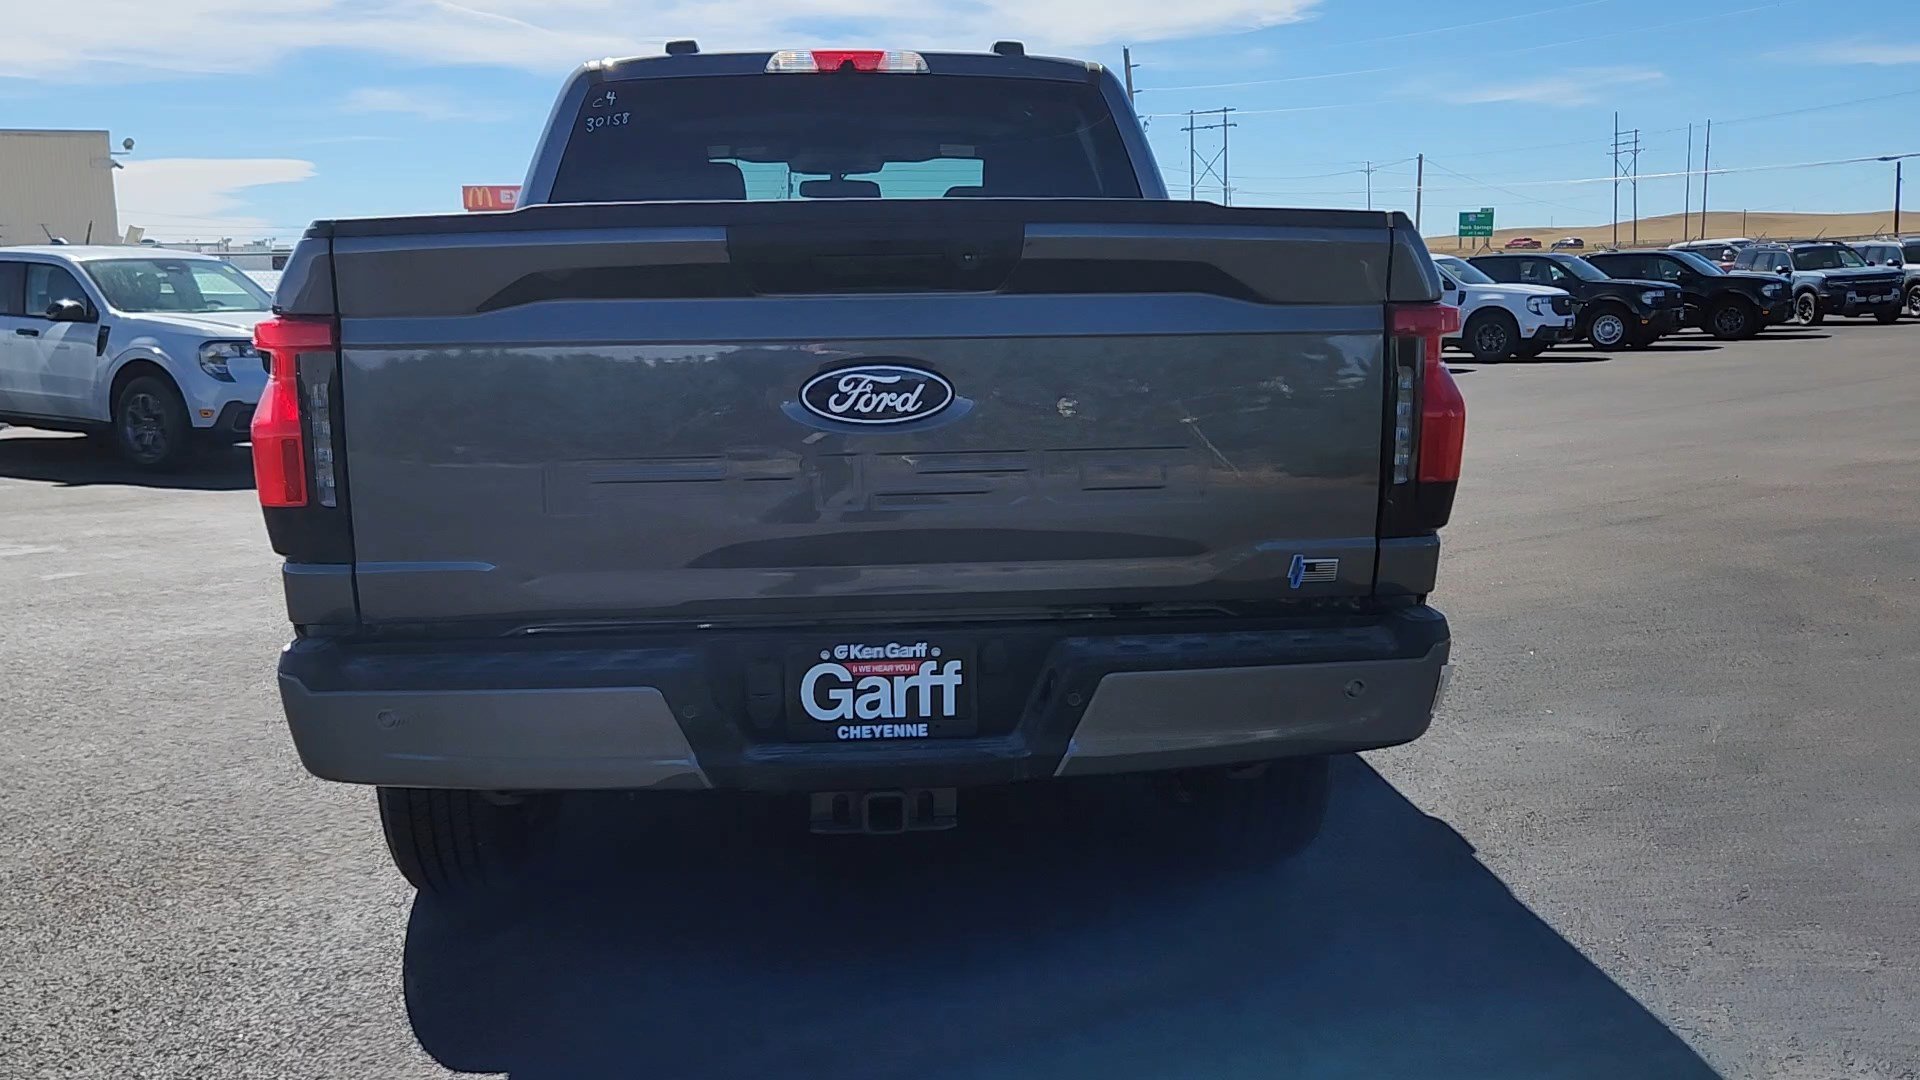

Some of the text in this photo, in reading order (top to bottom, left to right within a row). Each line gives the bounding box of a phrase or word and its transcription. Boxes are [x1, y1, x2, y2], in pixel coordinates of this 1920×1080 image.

[586, 112, 630, 133] 30158
[828, 373, 926, 414] Ford
[849, 644, 883, 660] Ken
[885, 642, 928, 659] Garff
[858, 663, 911, 673] WE HEAR YOU
[801, 660, 962, 721] Garff
[837, 723, 928, 739] CHEYENNE
